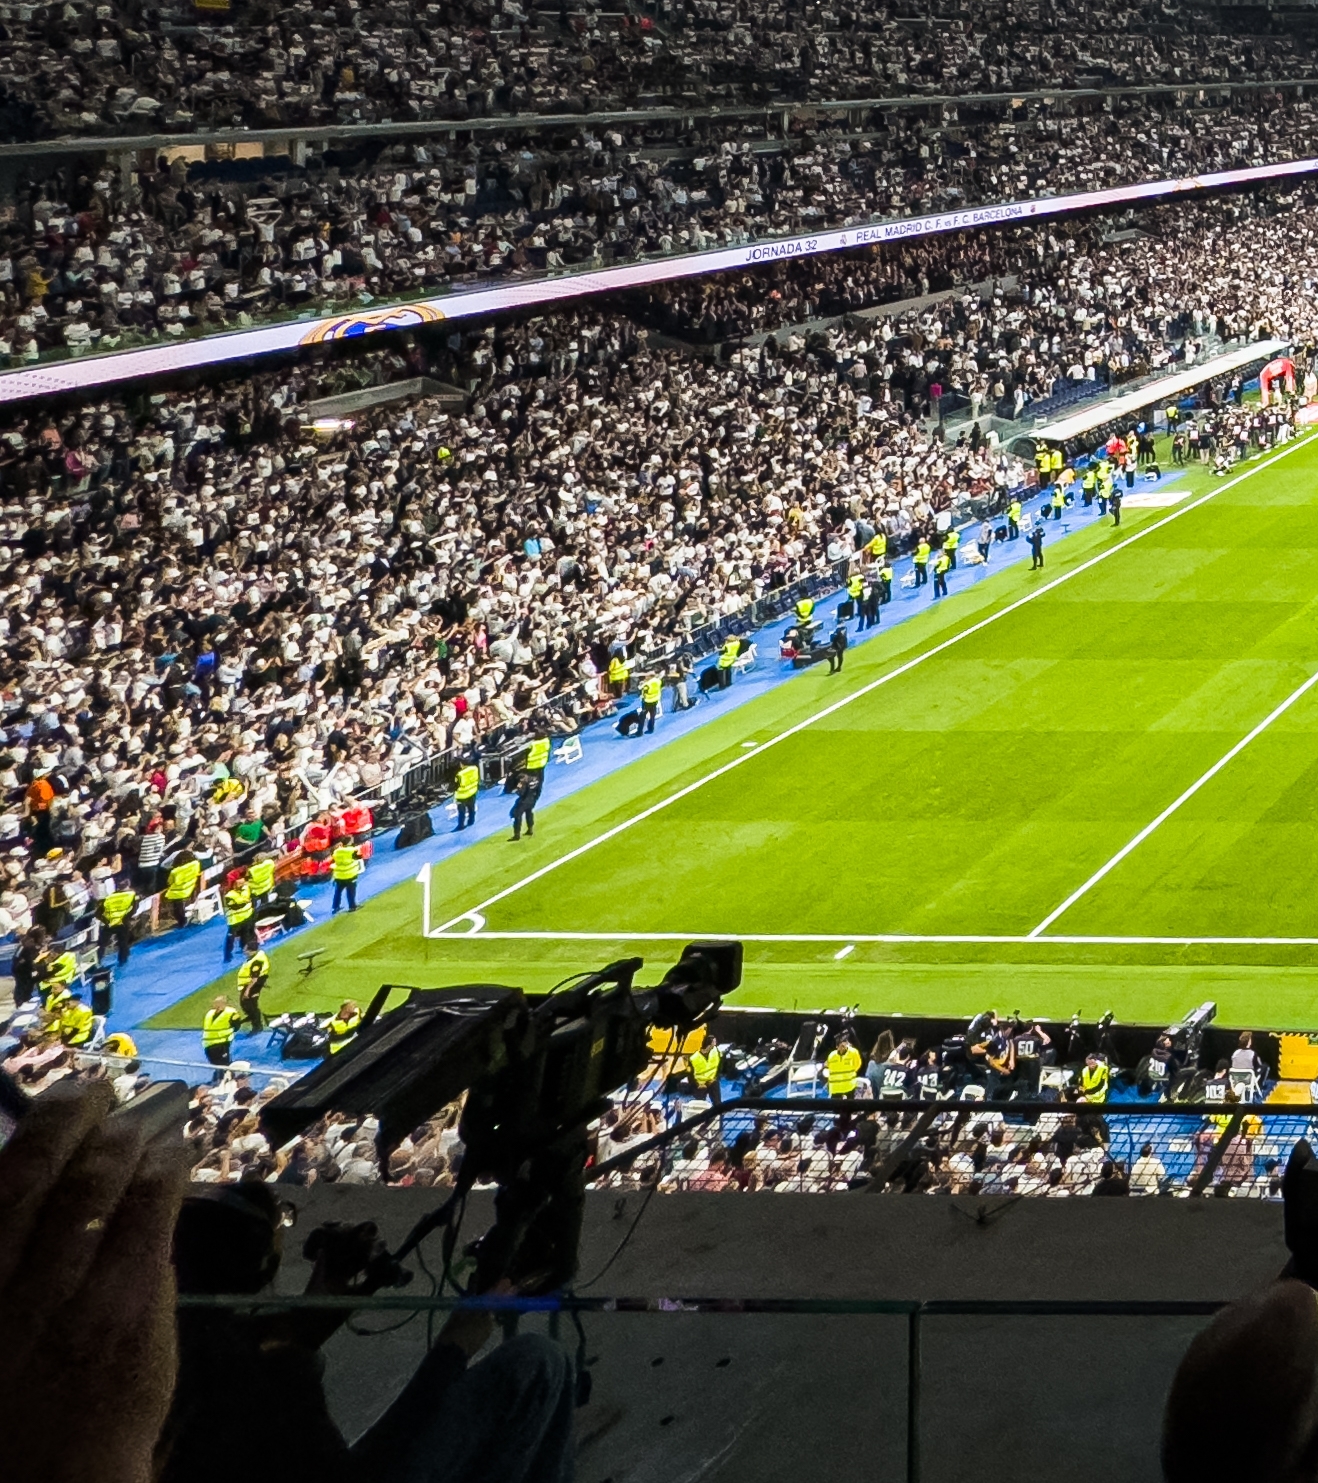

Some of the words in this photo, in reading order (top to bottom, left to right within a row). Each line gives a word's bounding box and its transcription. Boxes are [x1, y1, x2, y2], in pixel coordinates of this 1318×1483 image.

[746, 242, 802, 262] JORNADA
[804, 239, 818, 252] 32
[856, 229, 882, 243] REAL
[885, 222, 922, 238] MADRID
[973, 207, 1023, 223] BARCELONA
